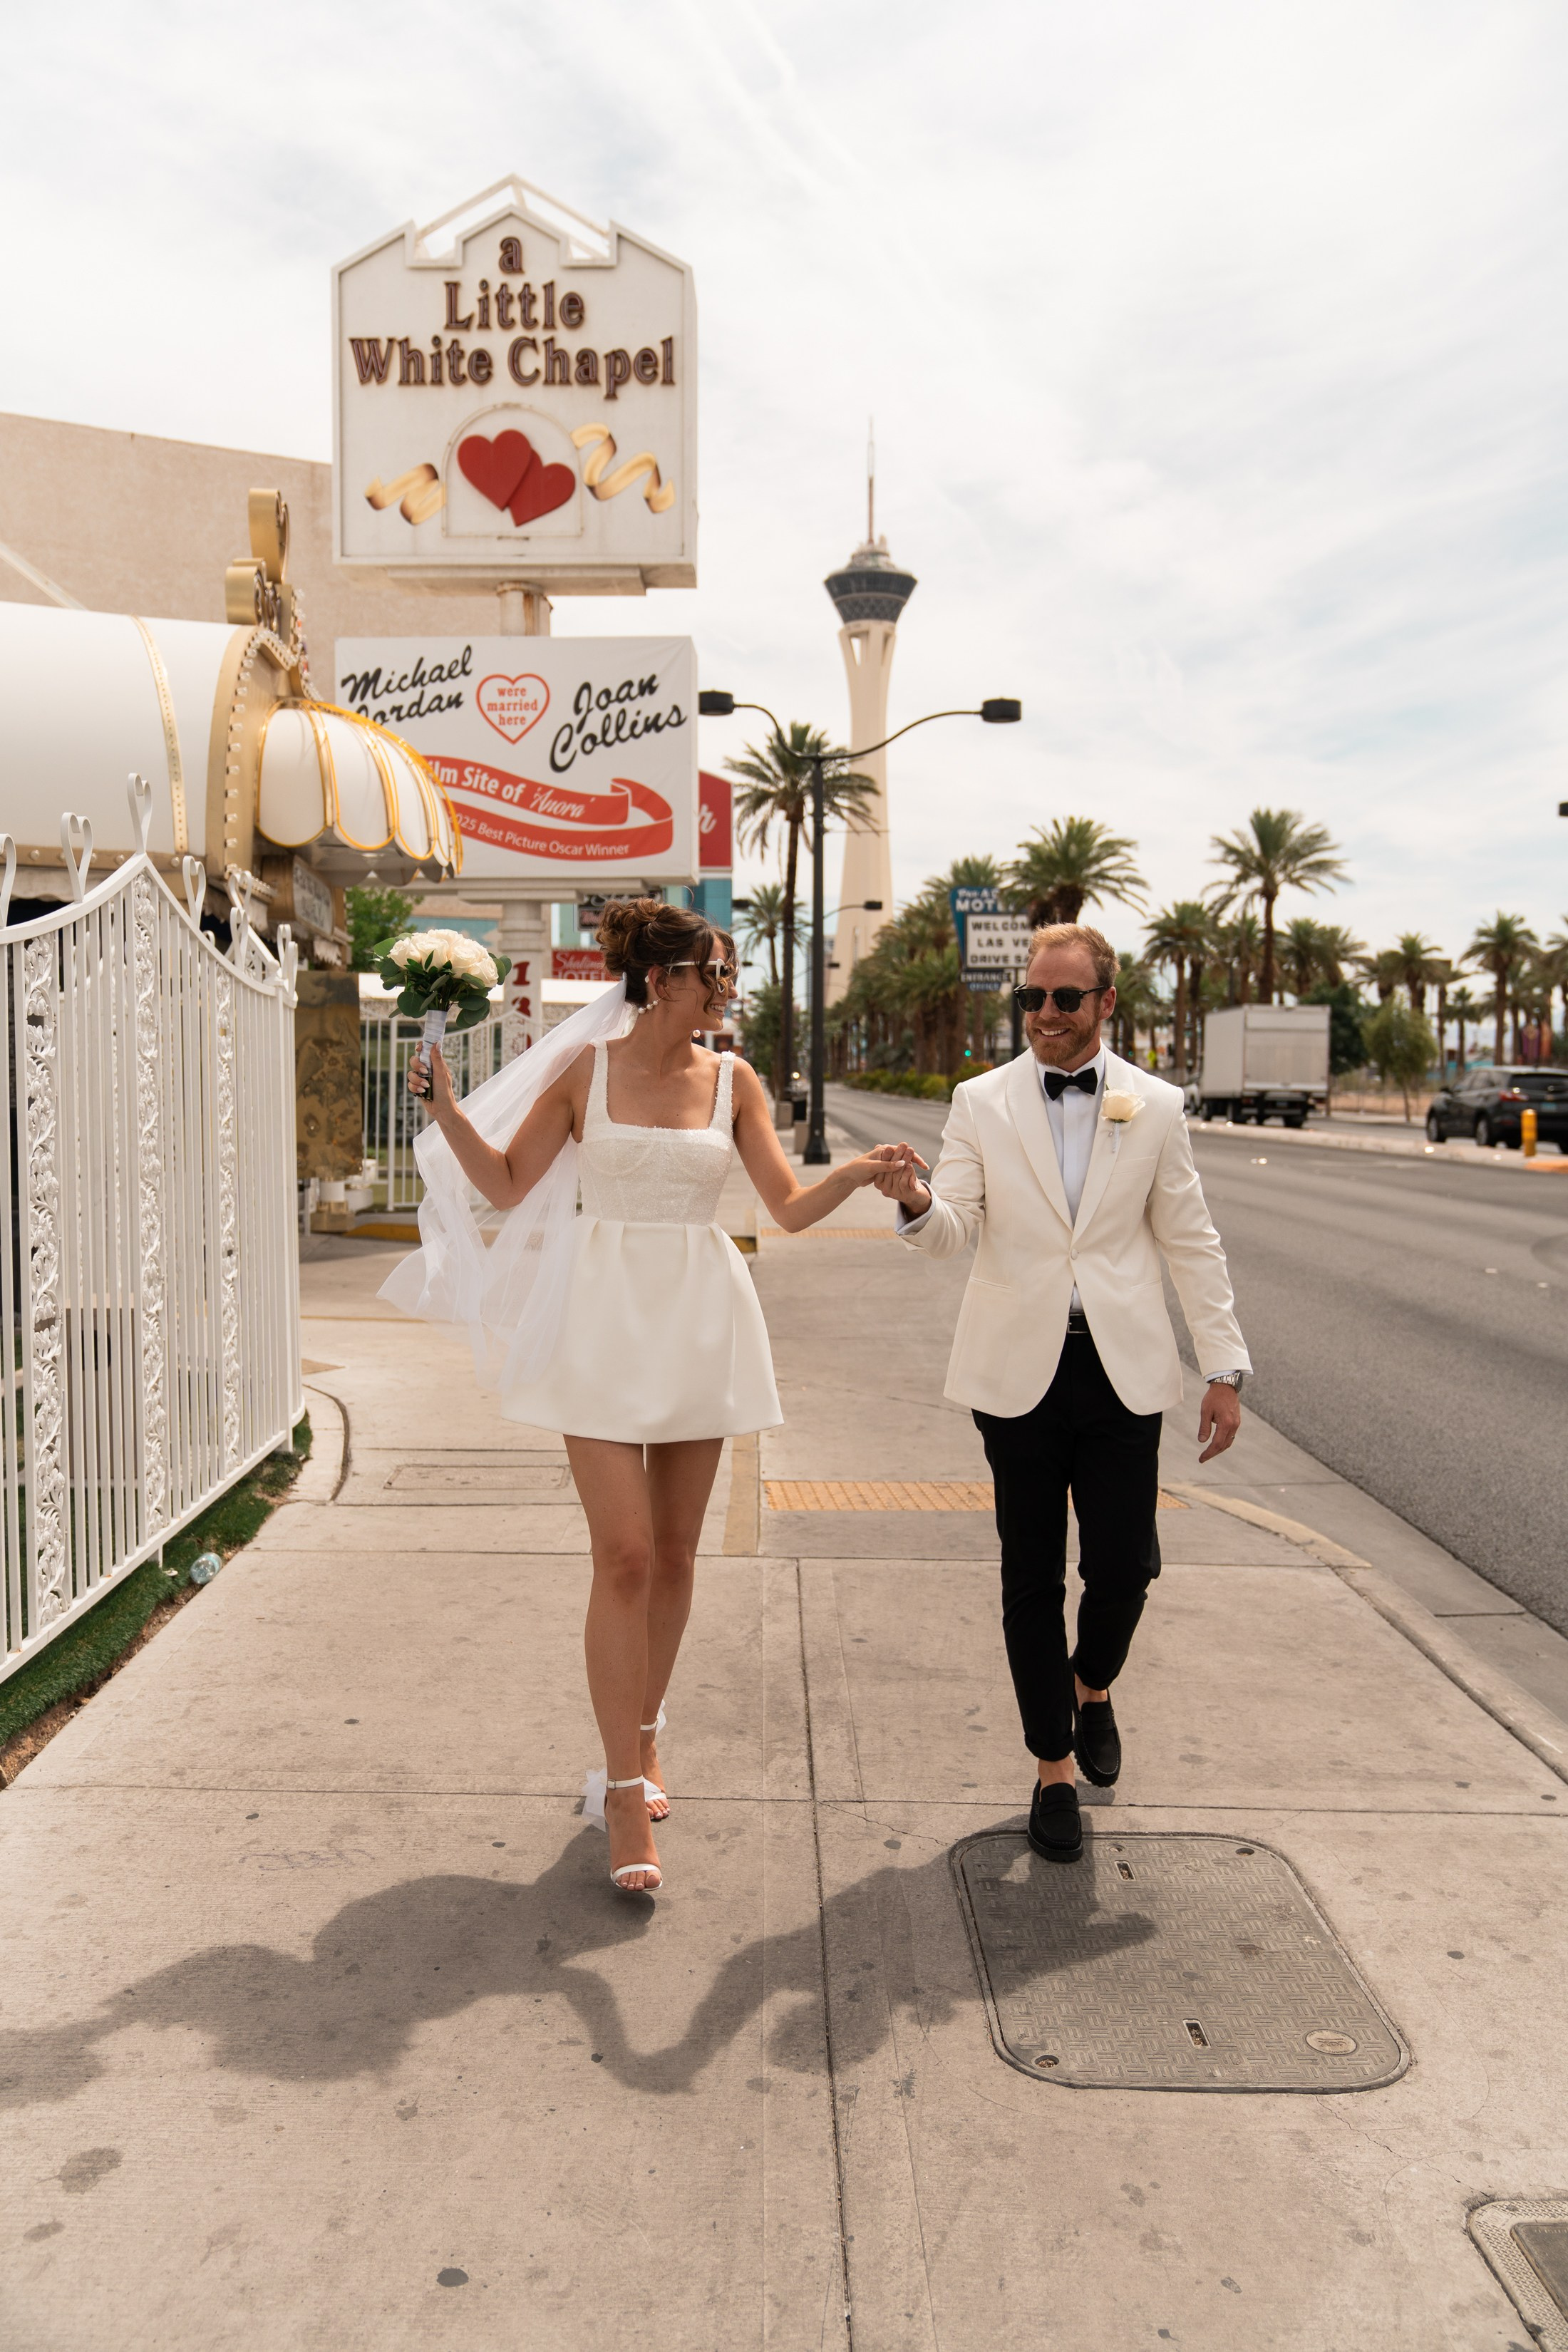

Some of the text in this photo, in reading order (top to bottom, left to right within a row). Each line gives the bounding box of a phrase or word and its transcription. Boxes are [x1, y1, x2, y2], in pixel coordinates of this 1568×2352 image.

[499, 236, 525, 274] a
[443, 278, 584, 331] Little
[349, 335, 676, 400] White Chapel
[341, 644, 473, 703] Michael
[487, 699, 538, 711] married
[497, 687, 527, 697] were
[573, 674, 659, 734] Joan
[499, 713, 526, 726] here
[550, 704, 687, 774] Collins
[461, 766, 500, 795] Site
[501, 783, 526, 803] of
[478, 822, 503, 841] Best
[505, 830, 547, 852] Picture
[549, 840, 583, 855] Oscar
[585, 844, 629, 856] Winner
[971, 922, 1031, 931] WELCOM
[977, 938, 1004, 947] LAS
[970, 955, 1009, 964] DRIVE
